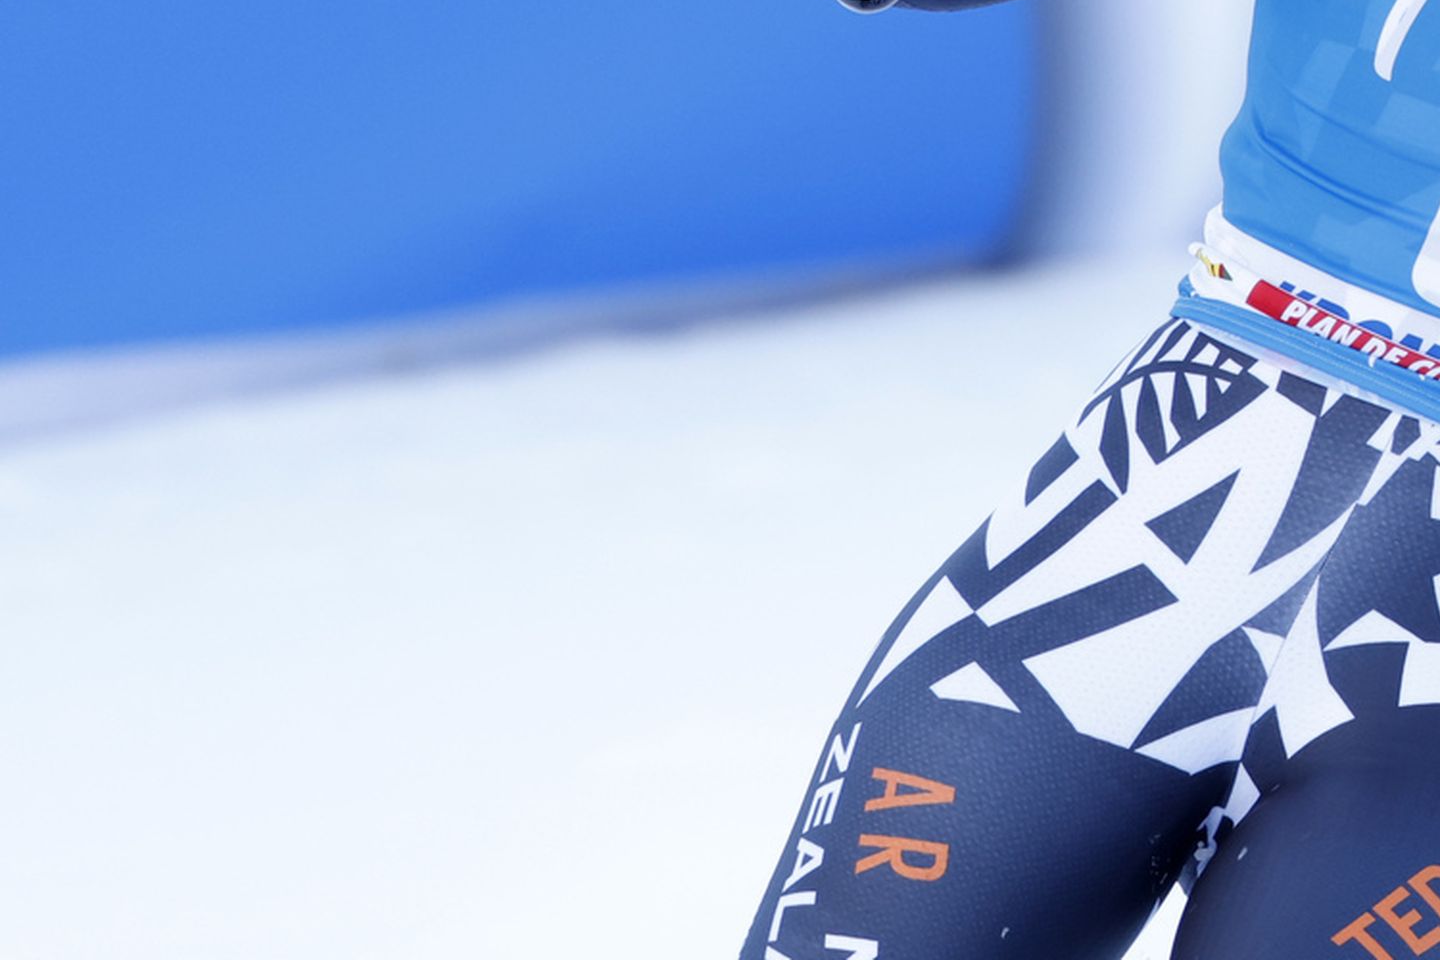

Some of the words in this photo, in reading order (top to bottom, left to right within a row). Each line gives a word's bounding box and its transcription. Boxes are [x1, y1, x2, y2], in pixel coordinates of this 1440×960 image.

[1280, 299, 1362, 347] PLAN
[1360, 336, 1408, 368] DE
[765, 722, 862, 960] ZEAL
[854, 767, 956, 881] AR
